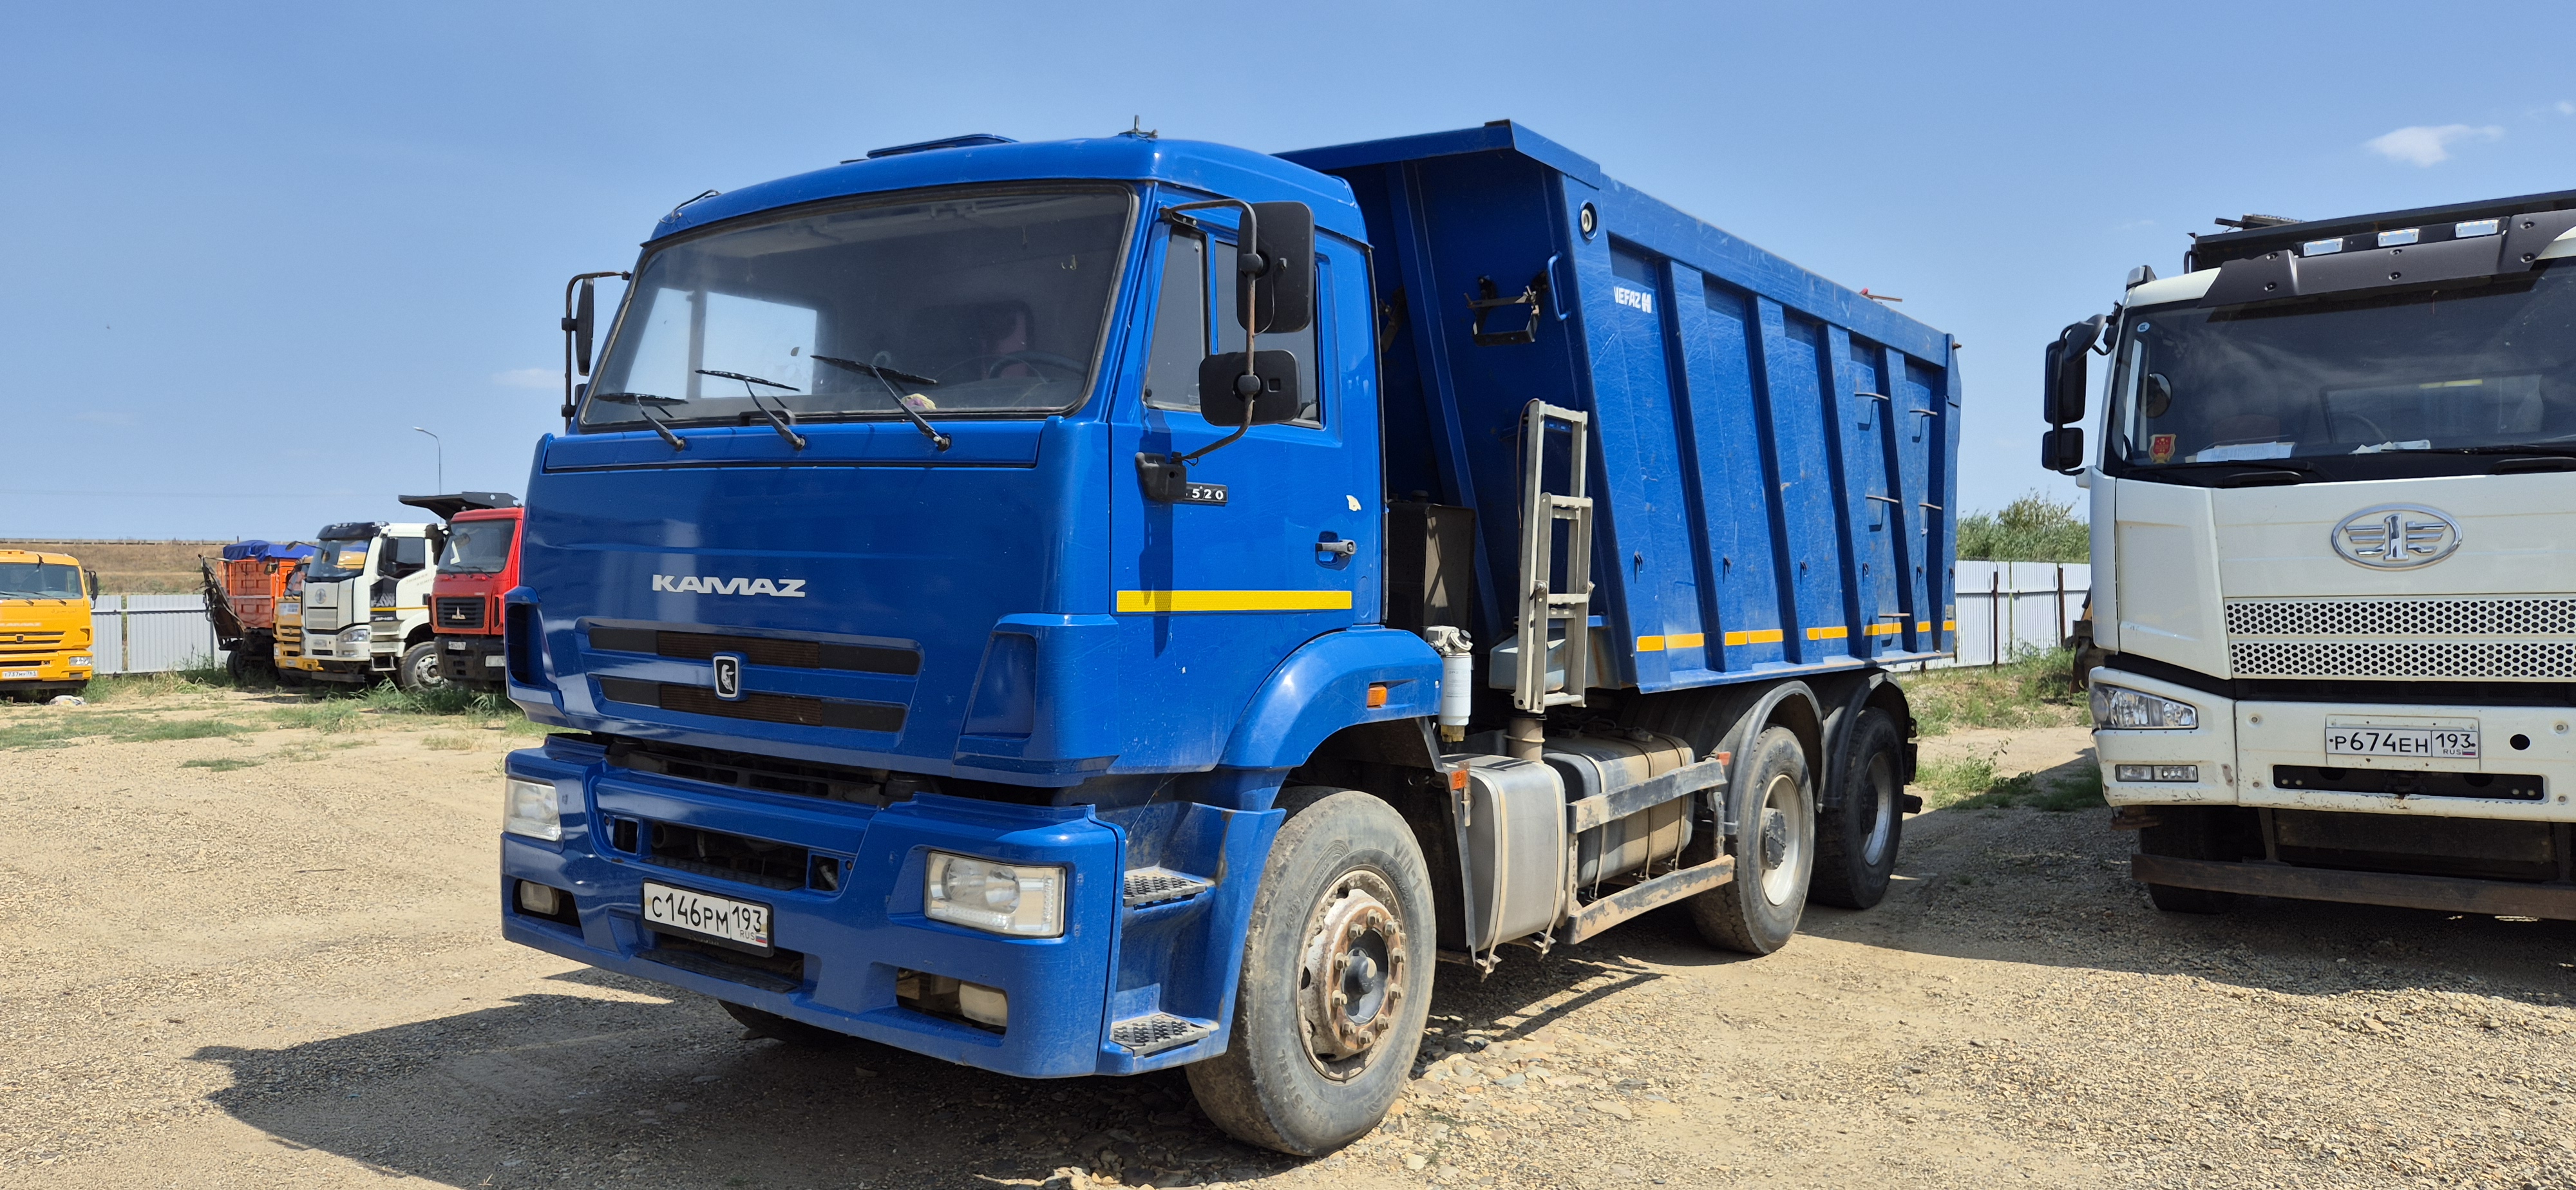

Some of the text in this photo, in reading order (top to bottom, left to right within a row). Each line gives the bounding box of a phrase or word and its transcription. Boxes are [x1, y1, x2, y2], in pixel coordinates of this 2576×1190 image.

[1186, 487, 1224, 500] 520
[652, 574, 806, 598] KAMAZ
[2334, 732, 2472, 753] Р674ЕН 193
[652, 892, 762, 934] С146РМ 193
[740, 929, 755, 940] RUS
